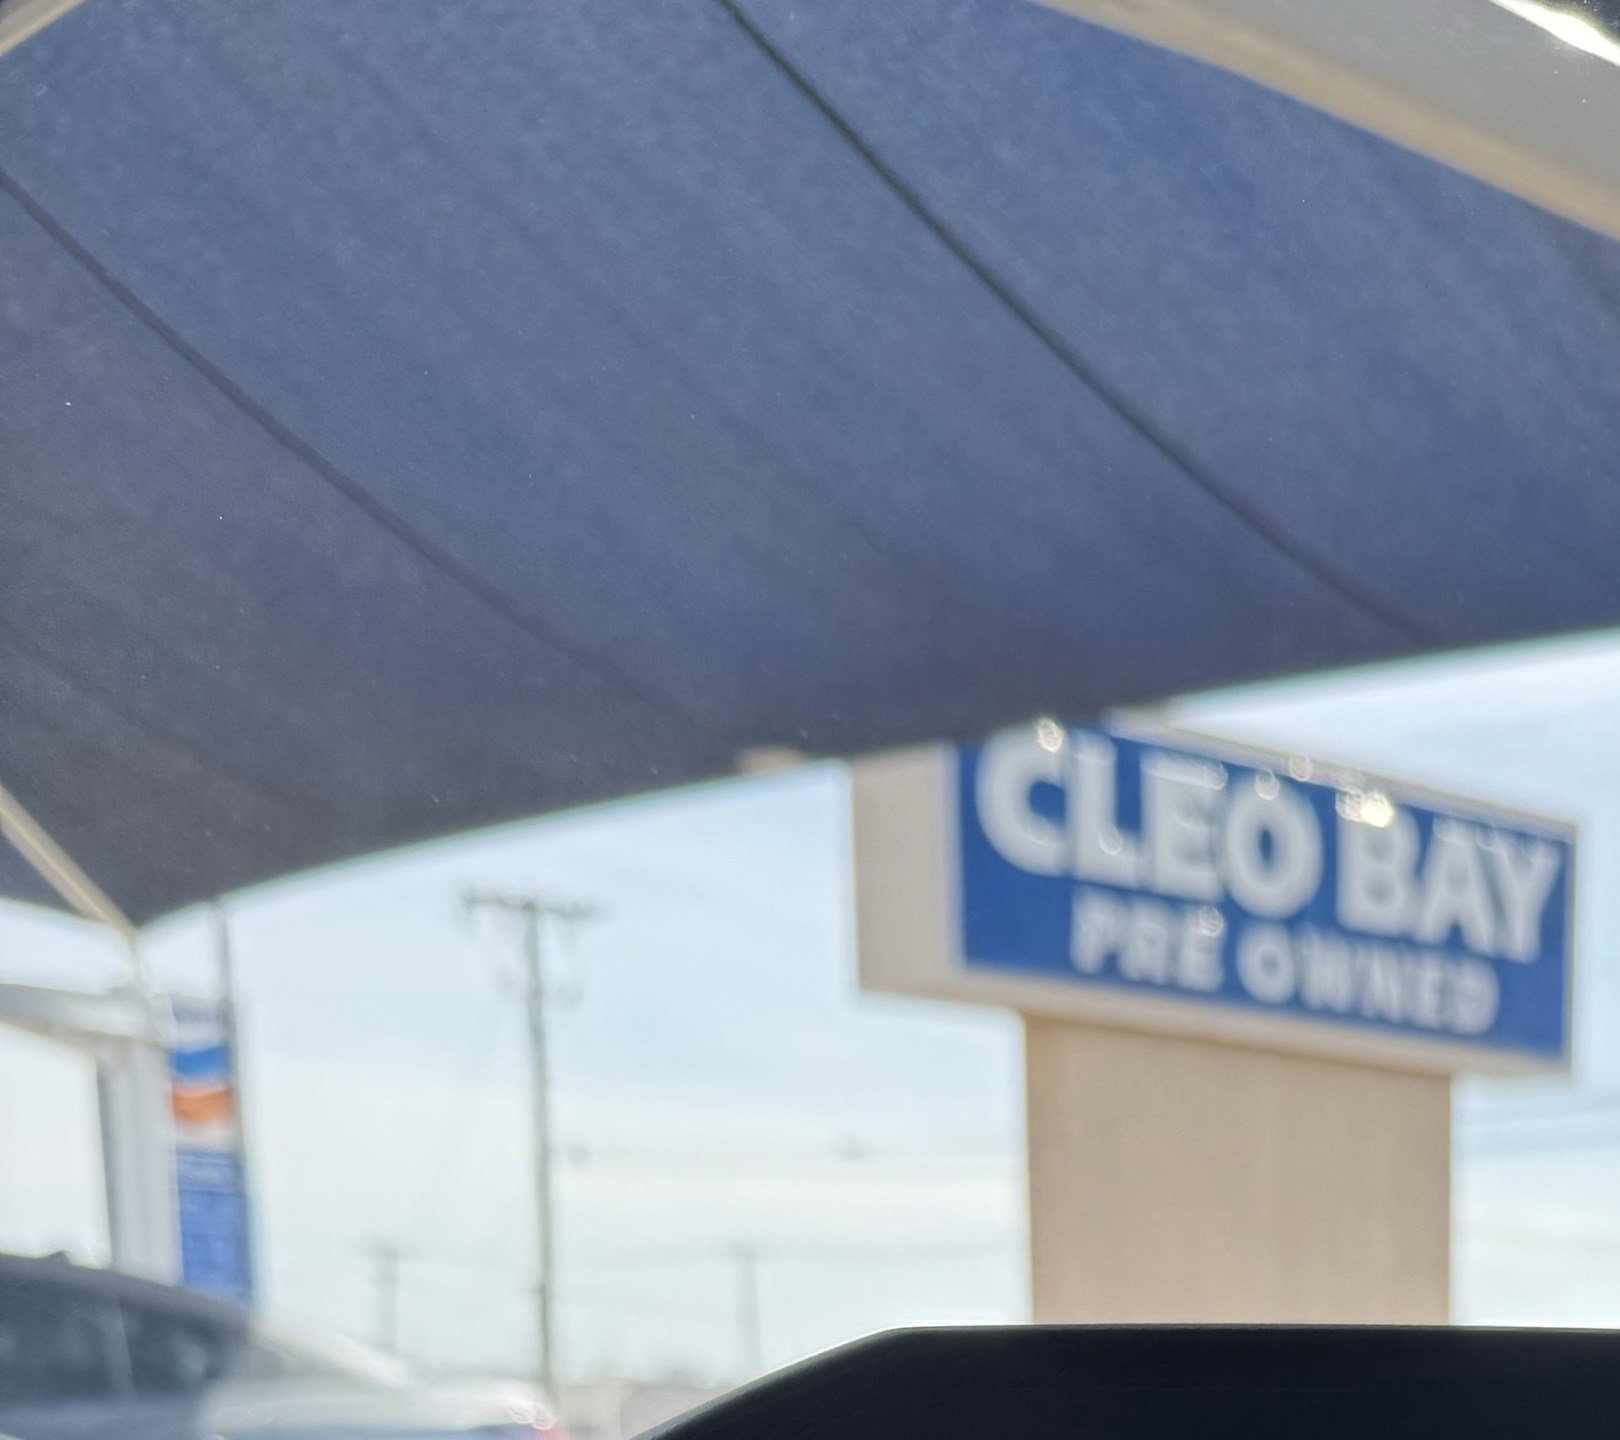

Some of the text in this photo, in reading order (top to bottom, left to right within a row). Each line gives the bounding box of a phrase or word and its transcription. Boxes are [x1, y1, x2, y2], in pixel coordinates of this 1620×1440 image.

[975, 722, 1560, 966] CLEO BAY
[1070, 888, 1500, 1036] PRE OWNED
